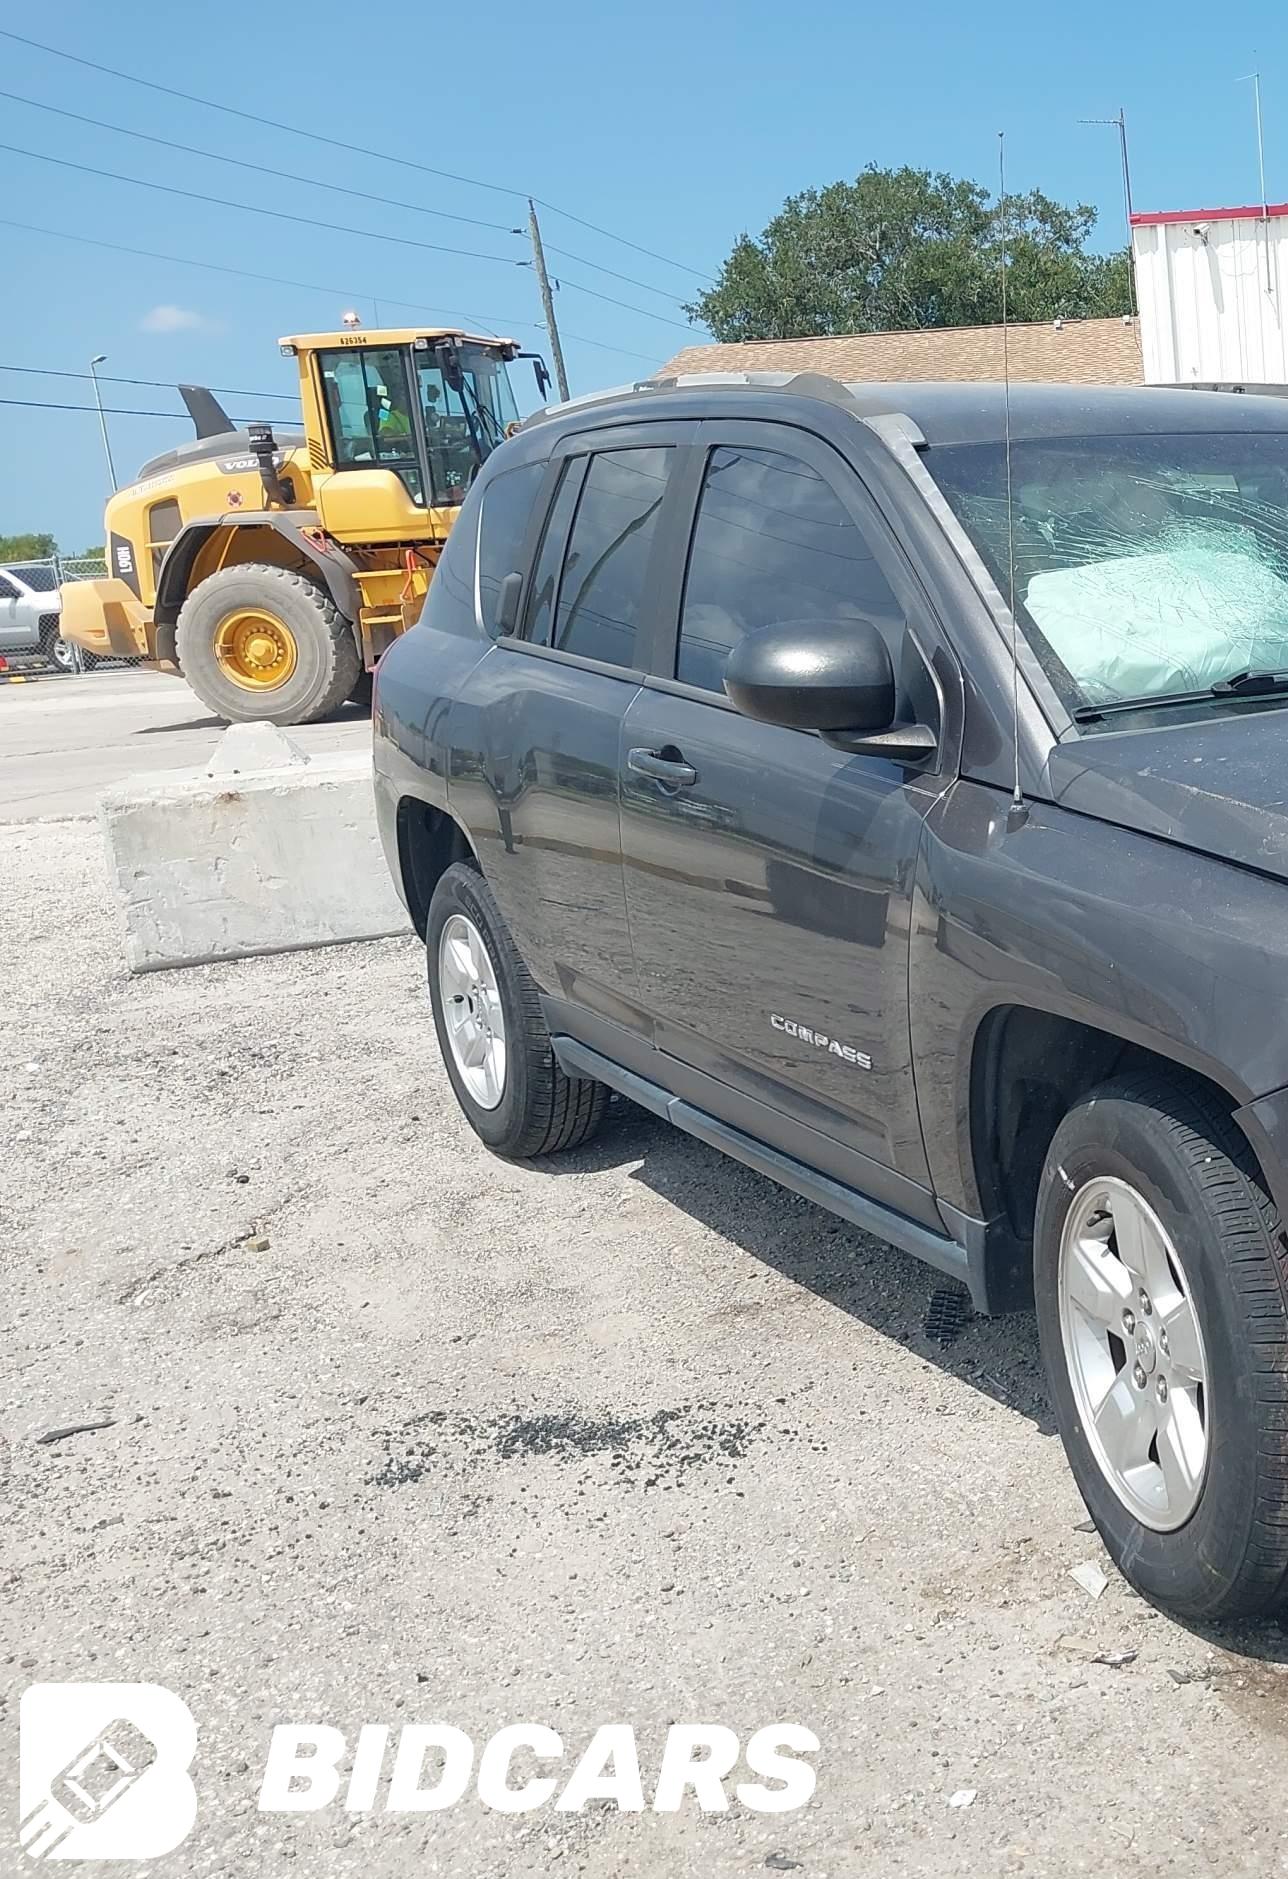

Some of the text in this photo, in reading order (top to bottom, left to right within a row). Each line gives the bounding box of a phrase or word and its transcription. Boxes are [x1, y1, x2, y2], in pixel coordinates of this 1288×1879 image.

[224, 456, 280, 470] VOLO
[116, 546, 133, 573] L90H
[770, 1013, 872, 1070] COMPASS
